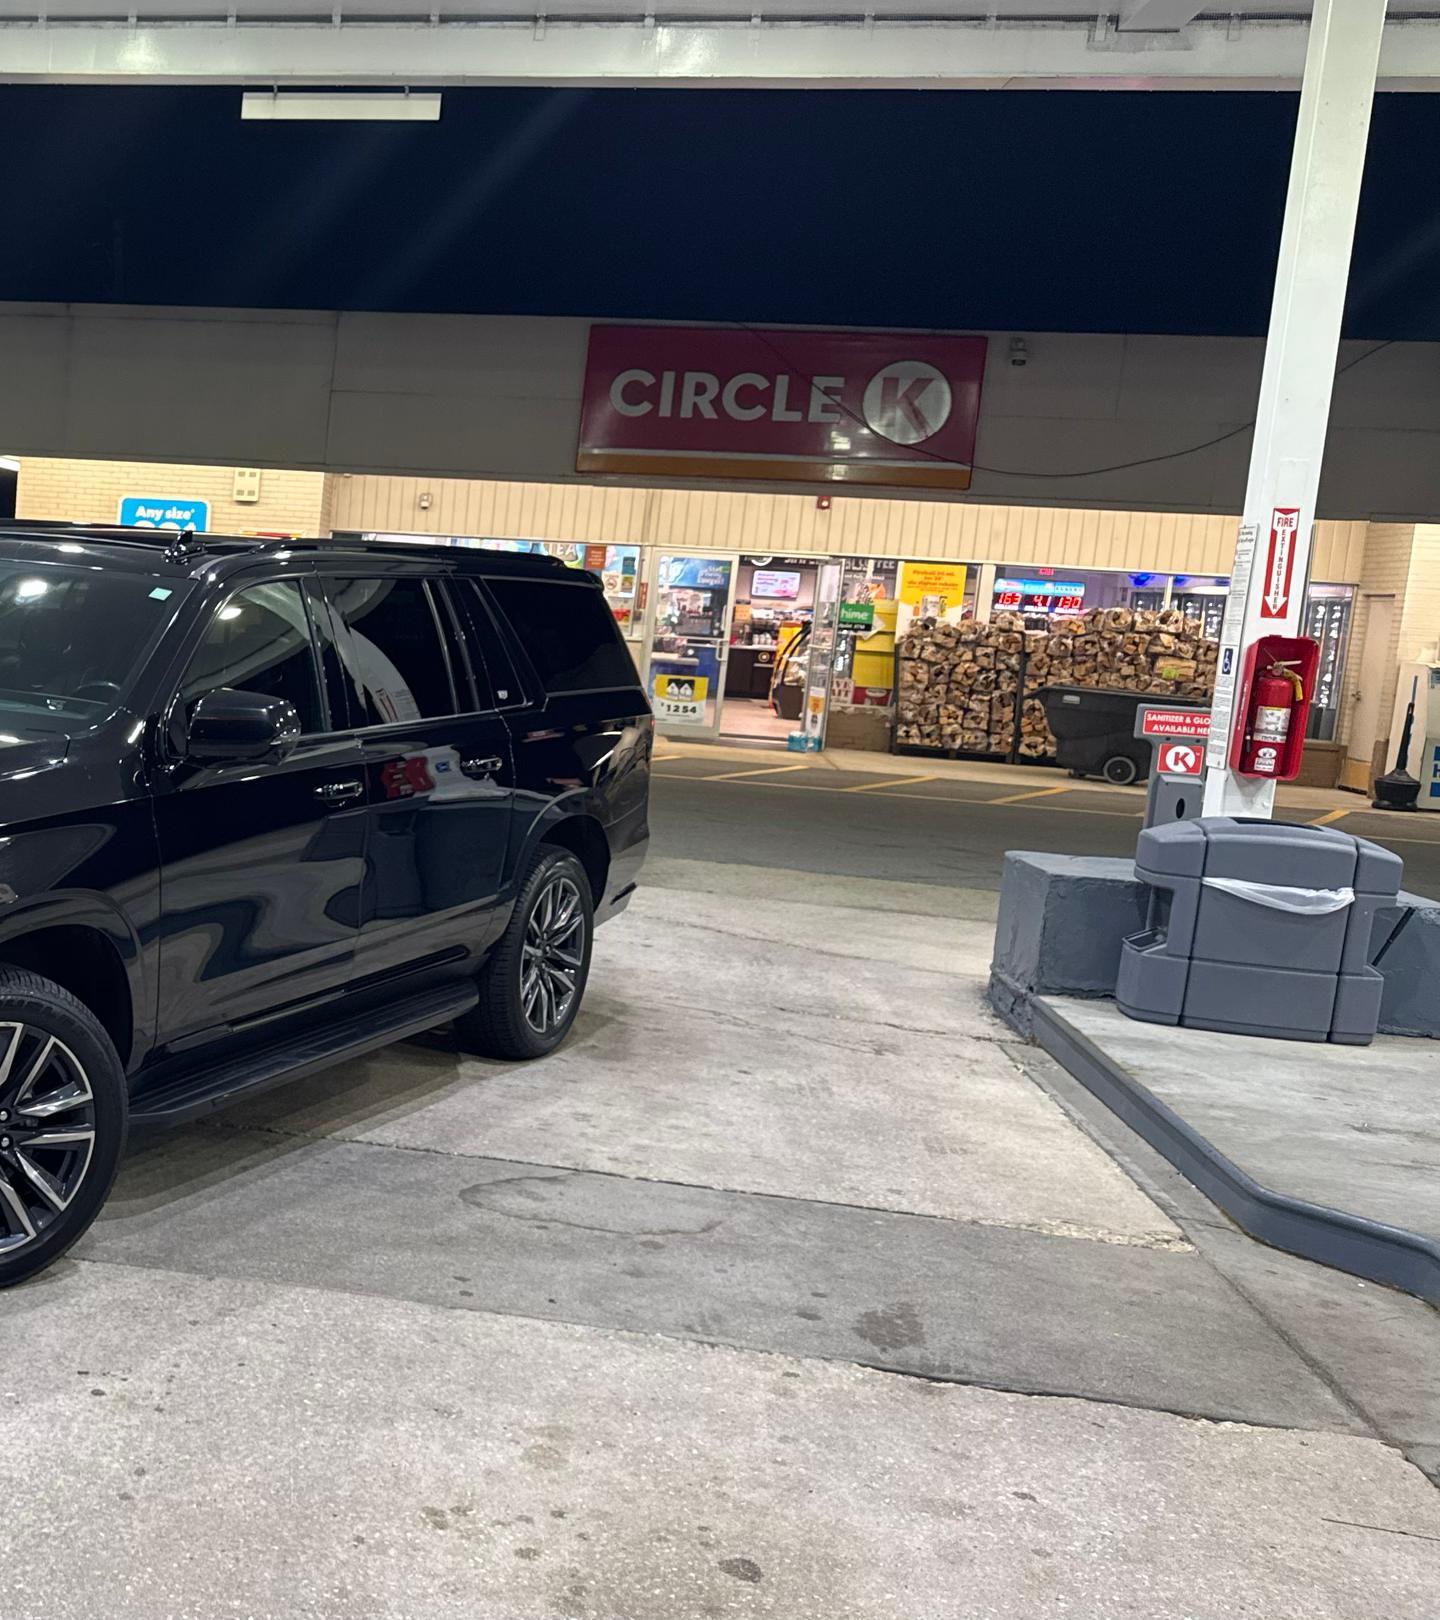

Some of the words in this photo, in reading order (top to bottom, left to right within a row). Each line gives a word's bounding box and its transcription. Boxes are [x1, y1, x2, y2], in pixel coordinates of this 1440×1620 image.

[608, 368, 846, 424] CIRCLE
[878, 376, 936, 440] K
[135, 505, 163, 520] Any
[1277, 517, 1293, 527] FIRE
[1272, 529, 1286, 610] EXTINGUISHER
[998, 592, 1022, 605] 163
[1058, 596, 1082, 608] 130
[840, 606, 868, 620] hime
[1146, 713, 1184, 723] SANITIZER
[1152, 724, 1196, 734] AVAILABLE
